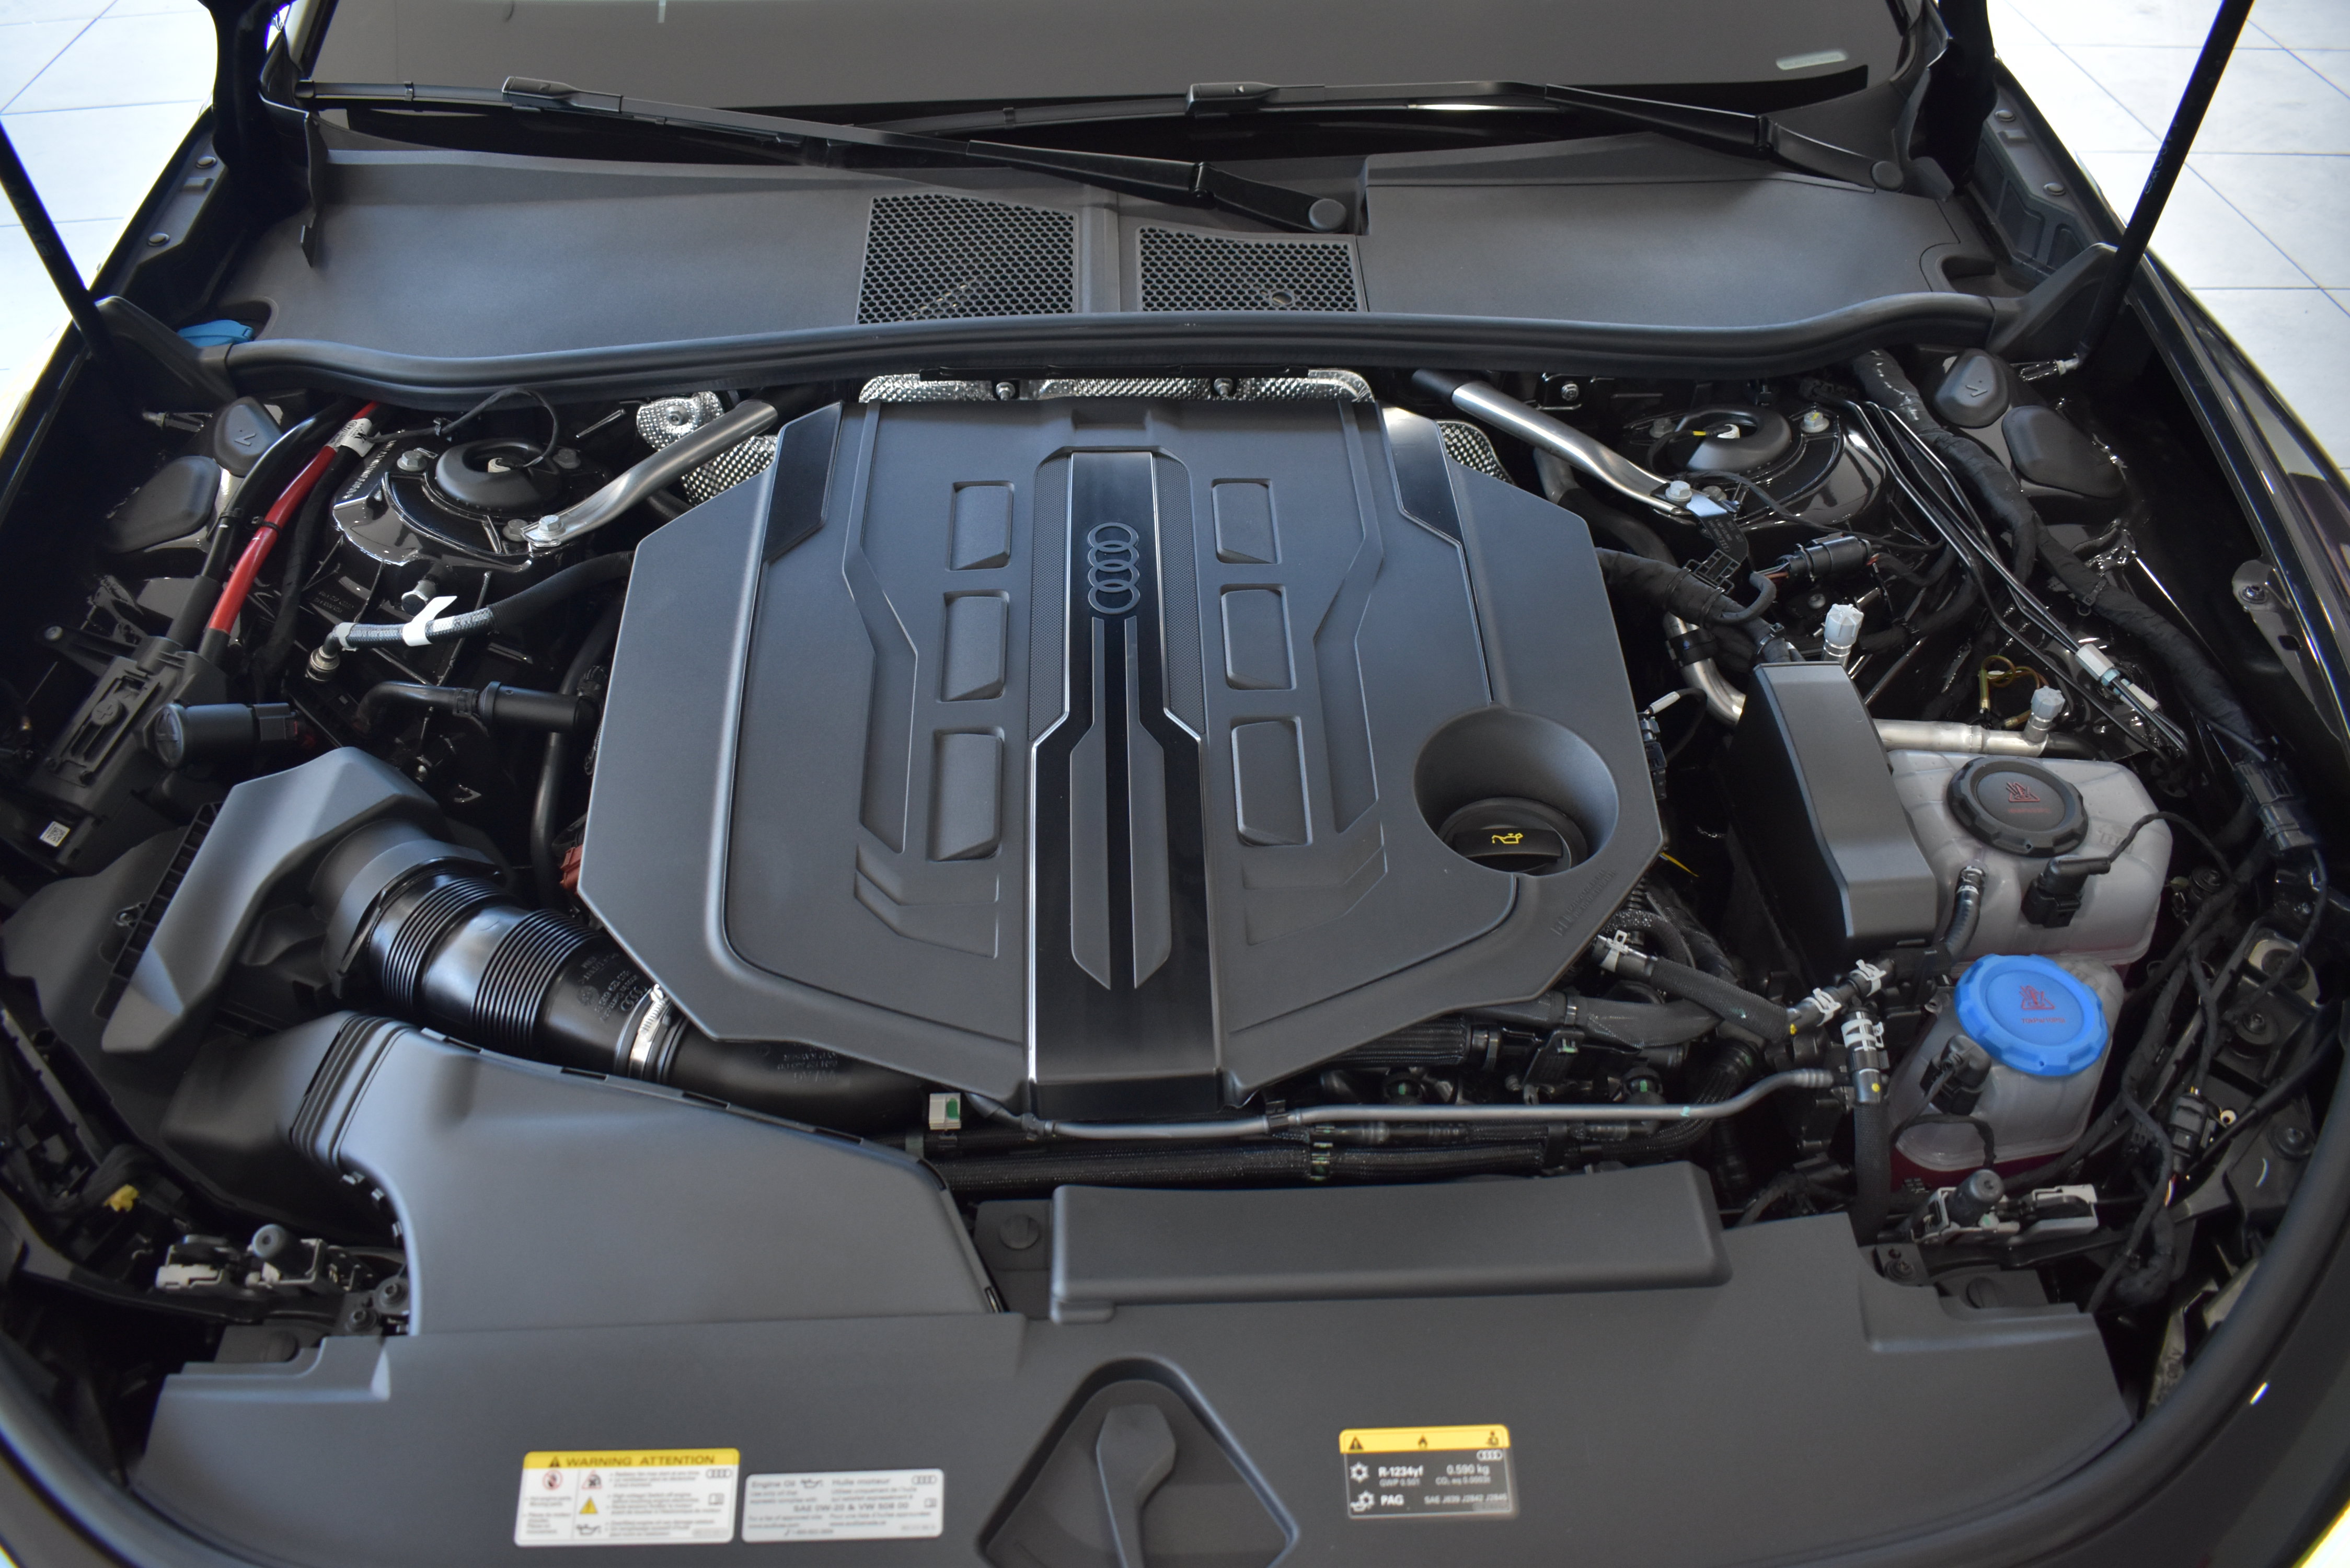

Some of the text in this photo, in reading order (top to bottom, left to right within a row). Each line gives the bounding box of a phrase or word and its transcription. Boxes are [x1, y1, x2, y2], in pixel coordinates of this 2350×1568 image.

[567, 1455, 715, 1467] WARNING ATTENTION
[1378, 1465, 1424, 1478] R-1234yf
[1477, 1463, 1490, 1476] kg
[1380, 1494, 1404, 1506] PAG
